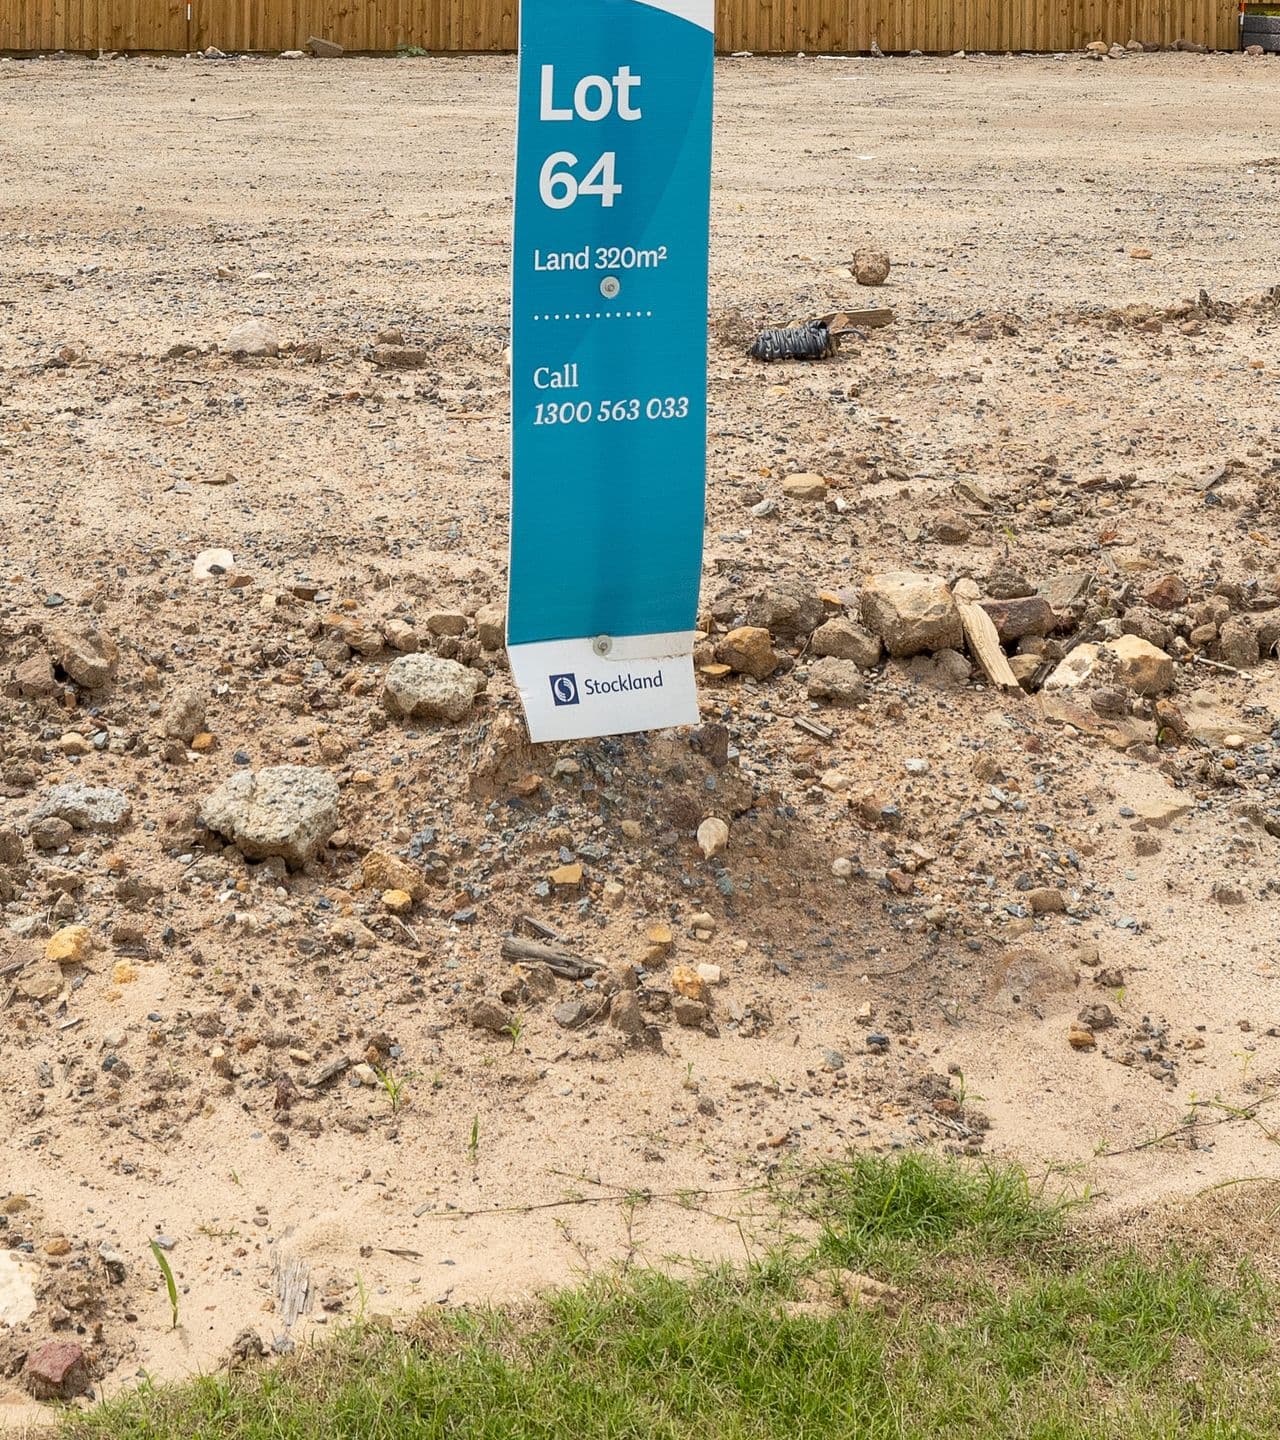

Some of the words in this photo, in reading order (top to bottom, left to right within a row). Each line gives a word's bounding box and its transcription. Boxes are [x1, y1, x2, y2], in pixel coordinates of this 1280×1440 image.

[539, 64, 642, 122] Lot
[538, 151, 622, 210] 64
[534, 246, 589, 271] Land
[533, 363, 579, 388] Call
[533, 401, 592, 425] 1300
[597, 399, 640, 421] 563
[646, 396, 689, 418] 033
[584, 670, 664, 695] Stockland
